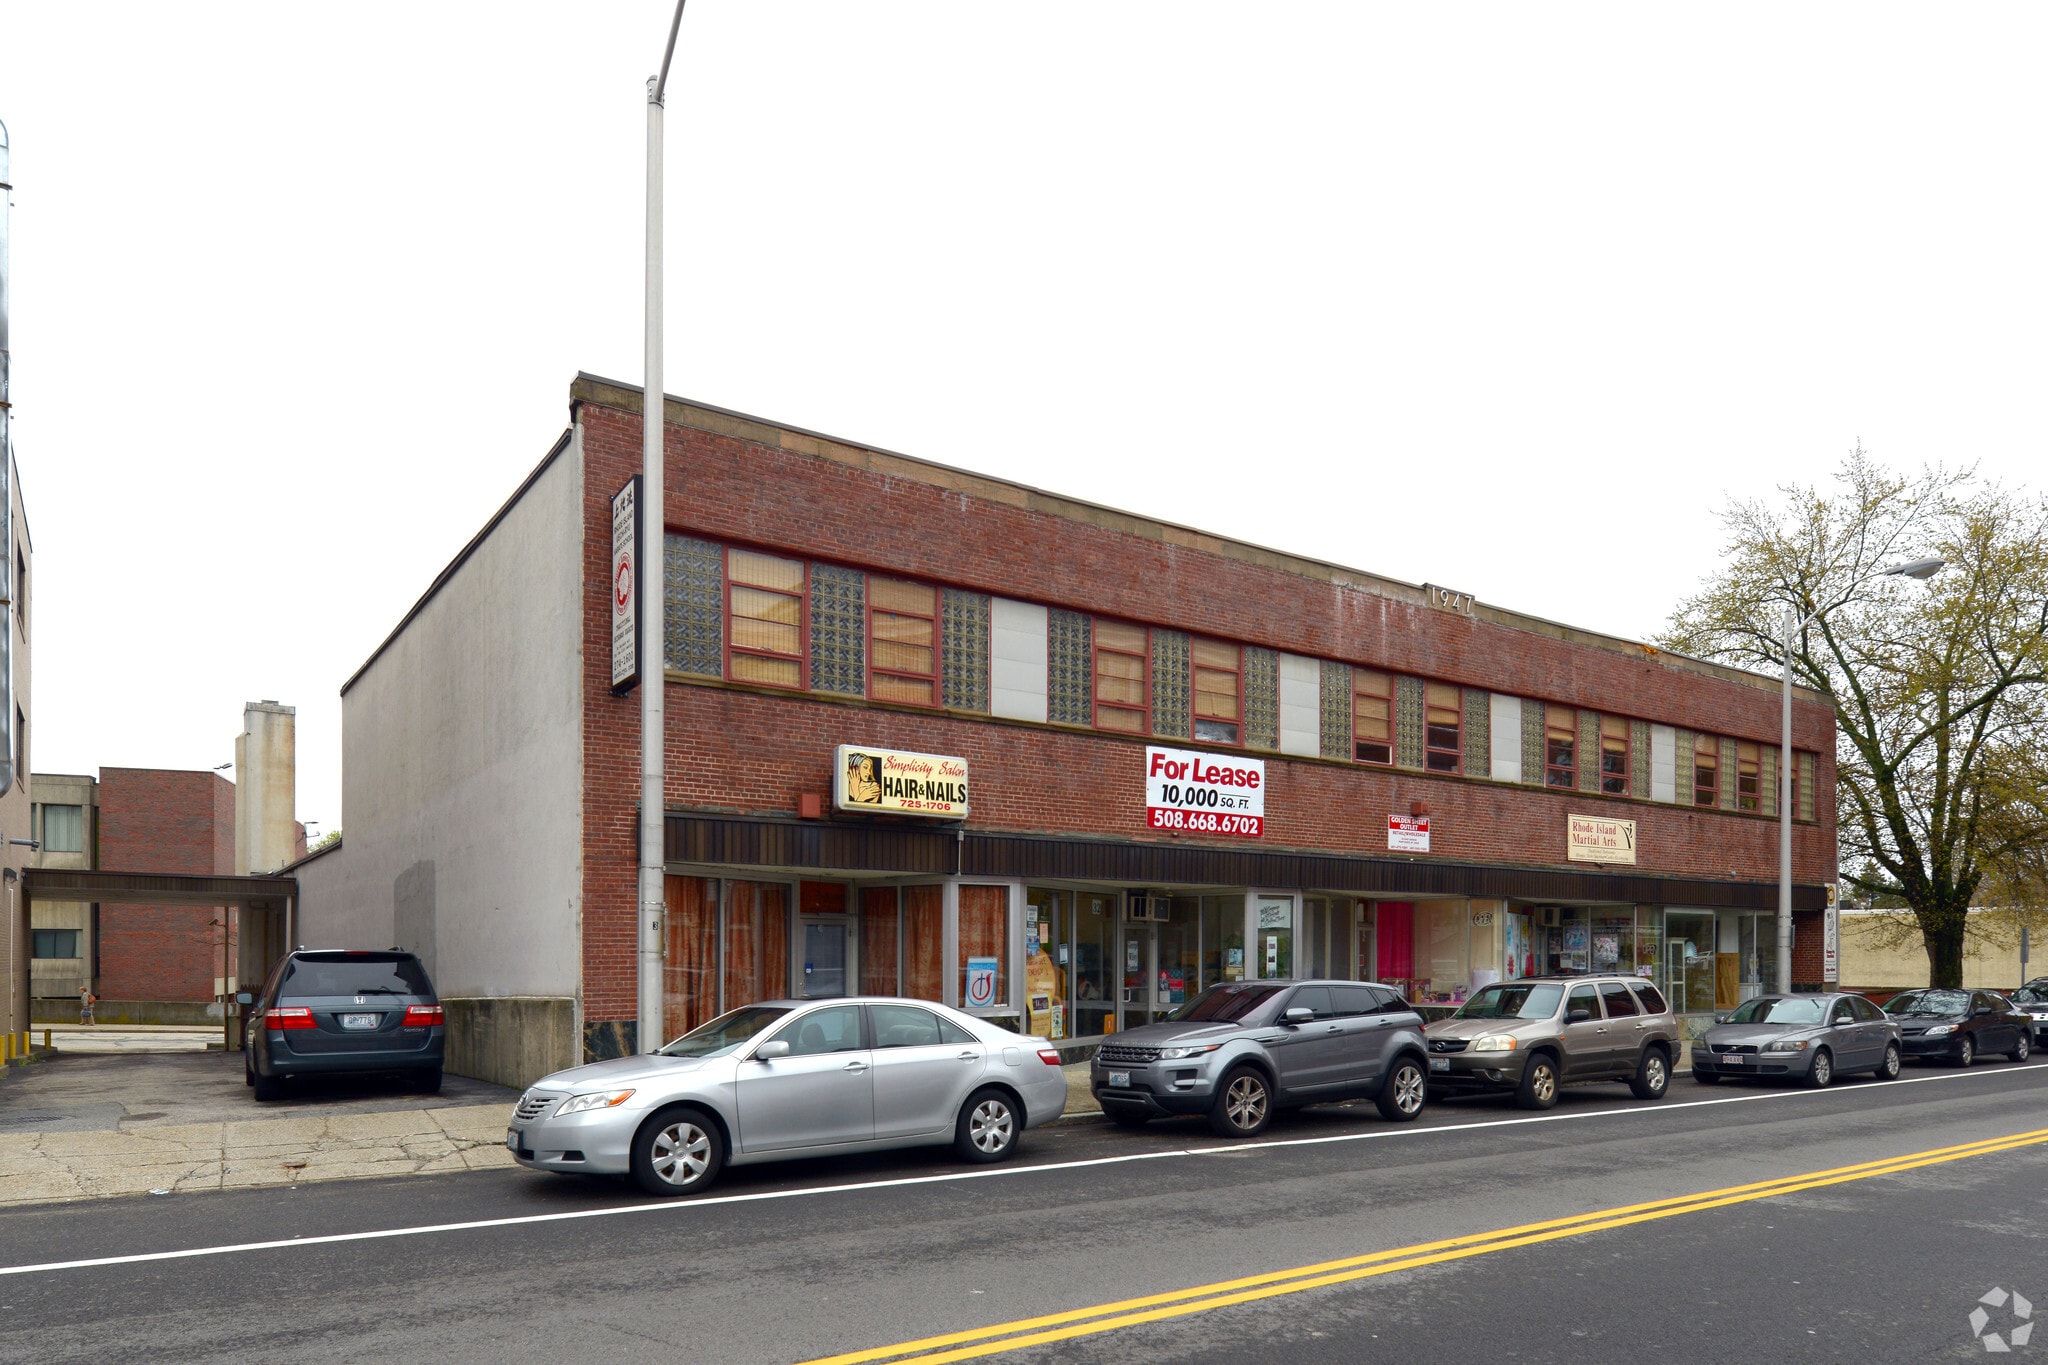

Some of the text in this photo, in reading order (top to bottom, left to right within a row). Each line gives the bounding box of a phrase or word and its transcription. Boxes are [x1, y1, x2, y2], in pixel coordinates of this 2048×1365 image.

[1432, 587, 1472, 613] 1947
[883, 755, 966, 778] Simplicity Salon
[1150, 753, 1260, 789] For Lease
[1161, 784, 1249, 810] 10,000 SQ. FT.
[900, 799, 951, 811] 725-1706
[1153, 809, 1259, 835] 508.668.6702
[1391, 816, 1427, 826] GOLDEN SHEET
[1400, 823, 1418, 831] OUTLET
[1572, 821, 1617, 835] Rhode Island
[1572, 833, 1617, 847] Martial Arts
[1092, 902, 1100, 913] 32
